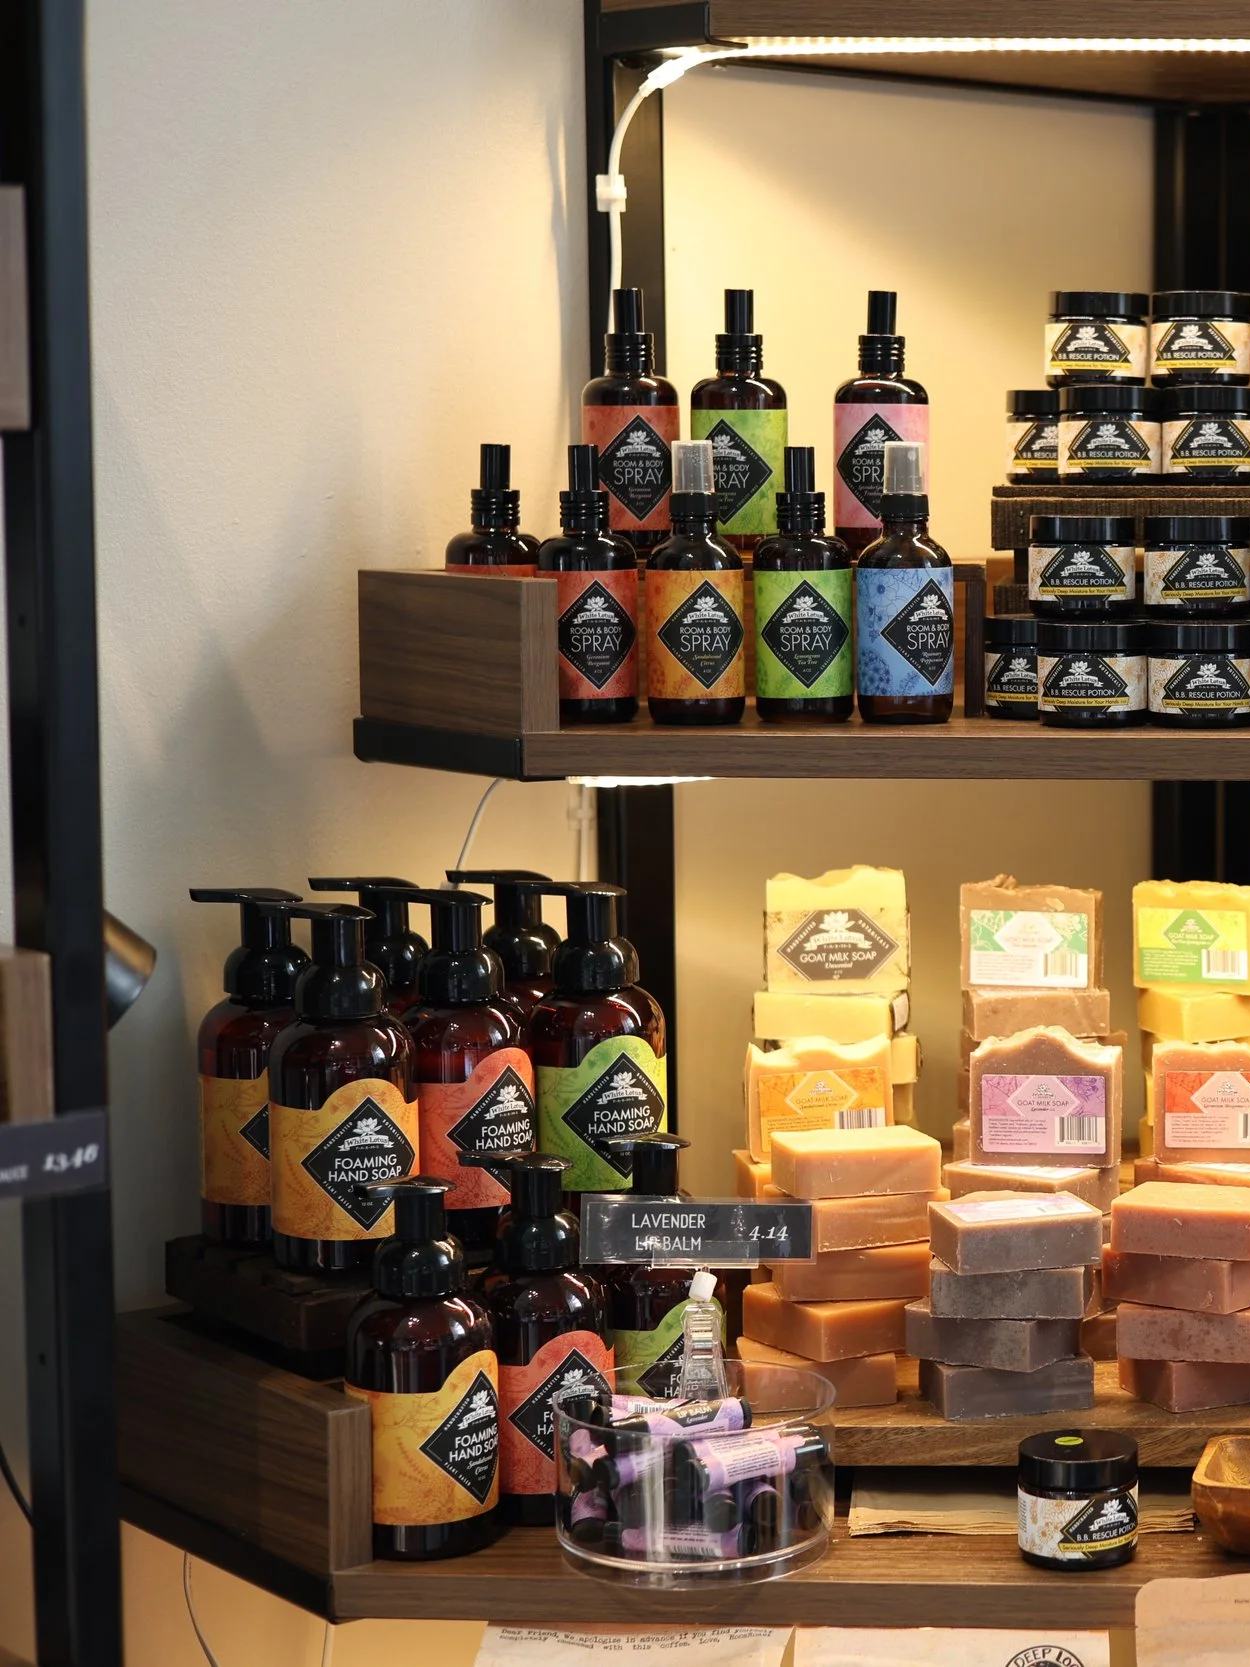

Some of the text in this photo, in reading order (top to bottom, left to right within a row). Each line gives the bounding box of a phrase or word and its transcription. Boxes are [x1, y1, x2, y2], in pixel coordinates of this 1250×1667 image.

[614, 468, 664, 485] SPRAY
[570, 626, 595, 634] ROOM
[603, 626, 622, 634] BODY
[679, 626, 701, 634] ROOM
[713, 626, 731, 634] BODY
[780, 626, 804, 634] ROOM
[813, 625, 832, 633] BODY
[907, 624, 931, 633] ROOM
[571, 634, 623, 652] SPRAY
[680, 634, 732, 652] SPRAY
[781, 633, 832, 651] SPRAY
[908, 632, 950, 650] SPRAY
[1061, 689, 1087, 697] RESCUE
[1188, 691, 1215, 699] RESCUE
[800, 950, 878, 963] GOAT MILK SOAP
[593, 1105, 651, 1122] FOAMING
[481, 1118, 530, 1138] FOAMING
[588, 1116, 655, 1135] HAND SOAP
[475, 1130, 533, 1150] HAND SOAP
[334, 1153, 398, 1170] FOAMING
[328, 1165, 402, 1182] HAND SOAP
[631, 1213, 706, 1229] LAVENDER
[748, 1225, 789, 1241] 4.14
[635, 1236, 702, 1251] LIP BALM
[454, 1422, 498, 1449] FOAMING
[449, 1444, 483, 1463] HAND
[1076, 1532, 1091, 1542] B.B.
[1092, 1528, 1118, 1541] RESCUE
[1013, 1647, 1052, 1667] DEEP
